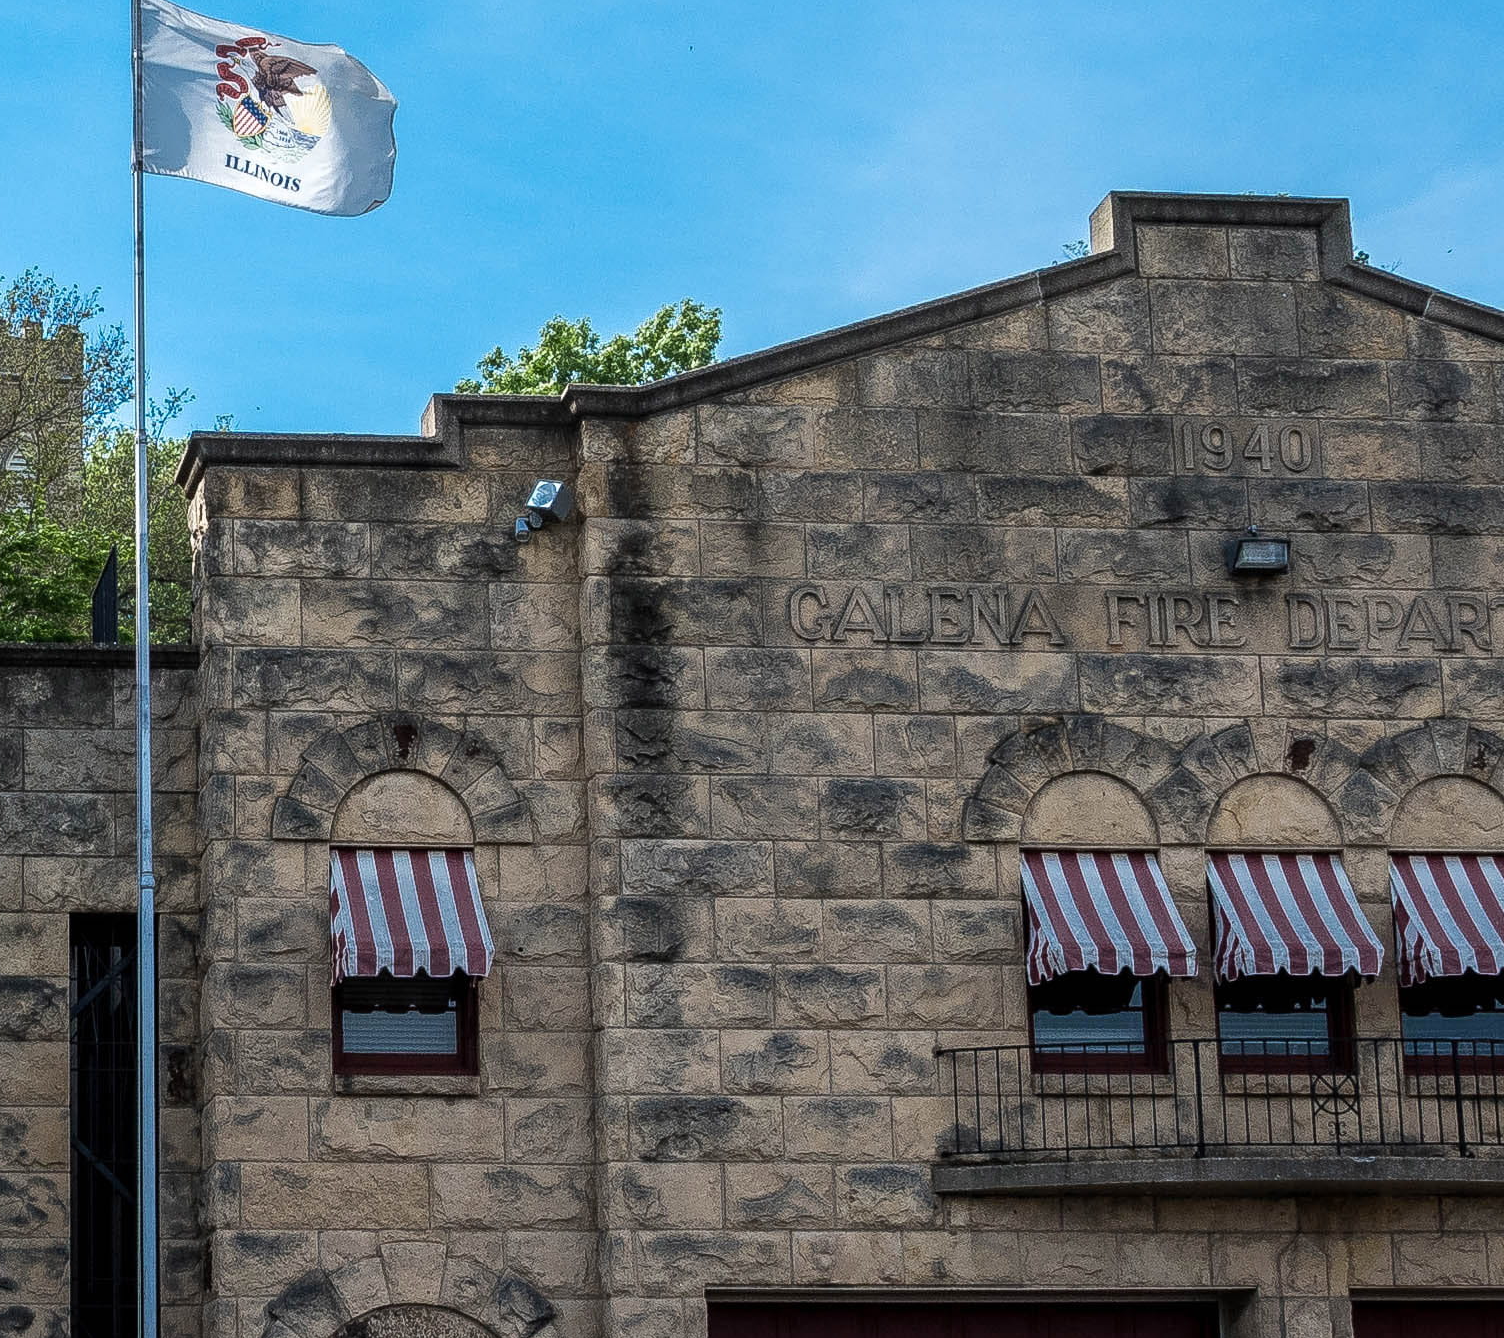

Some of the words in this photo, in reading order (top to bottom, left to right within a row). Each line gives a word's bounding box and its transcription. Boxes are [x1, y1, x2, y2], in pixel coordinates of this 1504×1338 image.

[225, 154, 302, 192] ILLINOIS
[1179, 421, 1315, 473] 1940
[789, 585, 1067, 647] GALENA
[1105, 588, 1247, 649] FIRE
